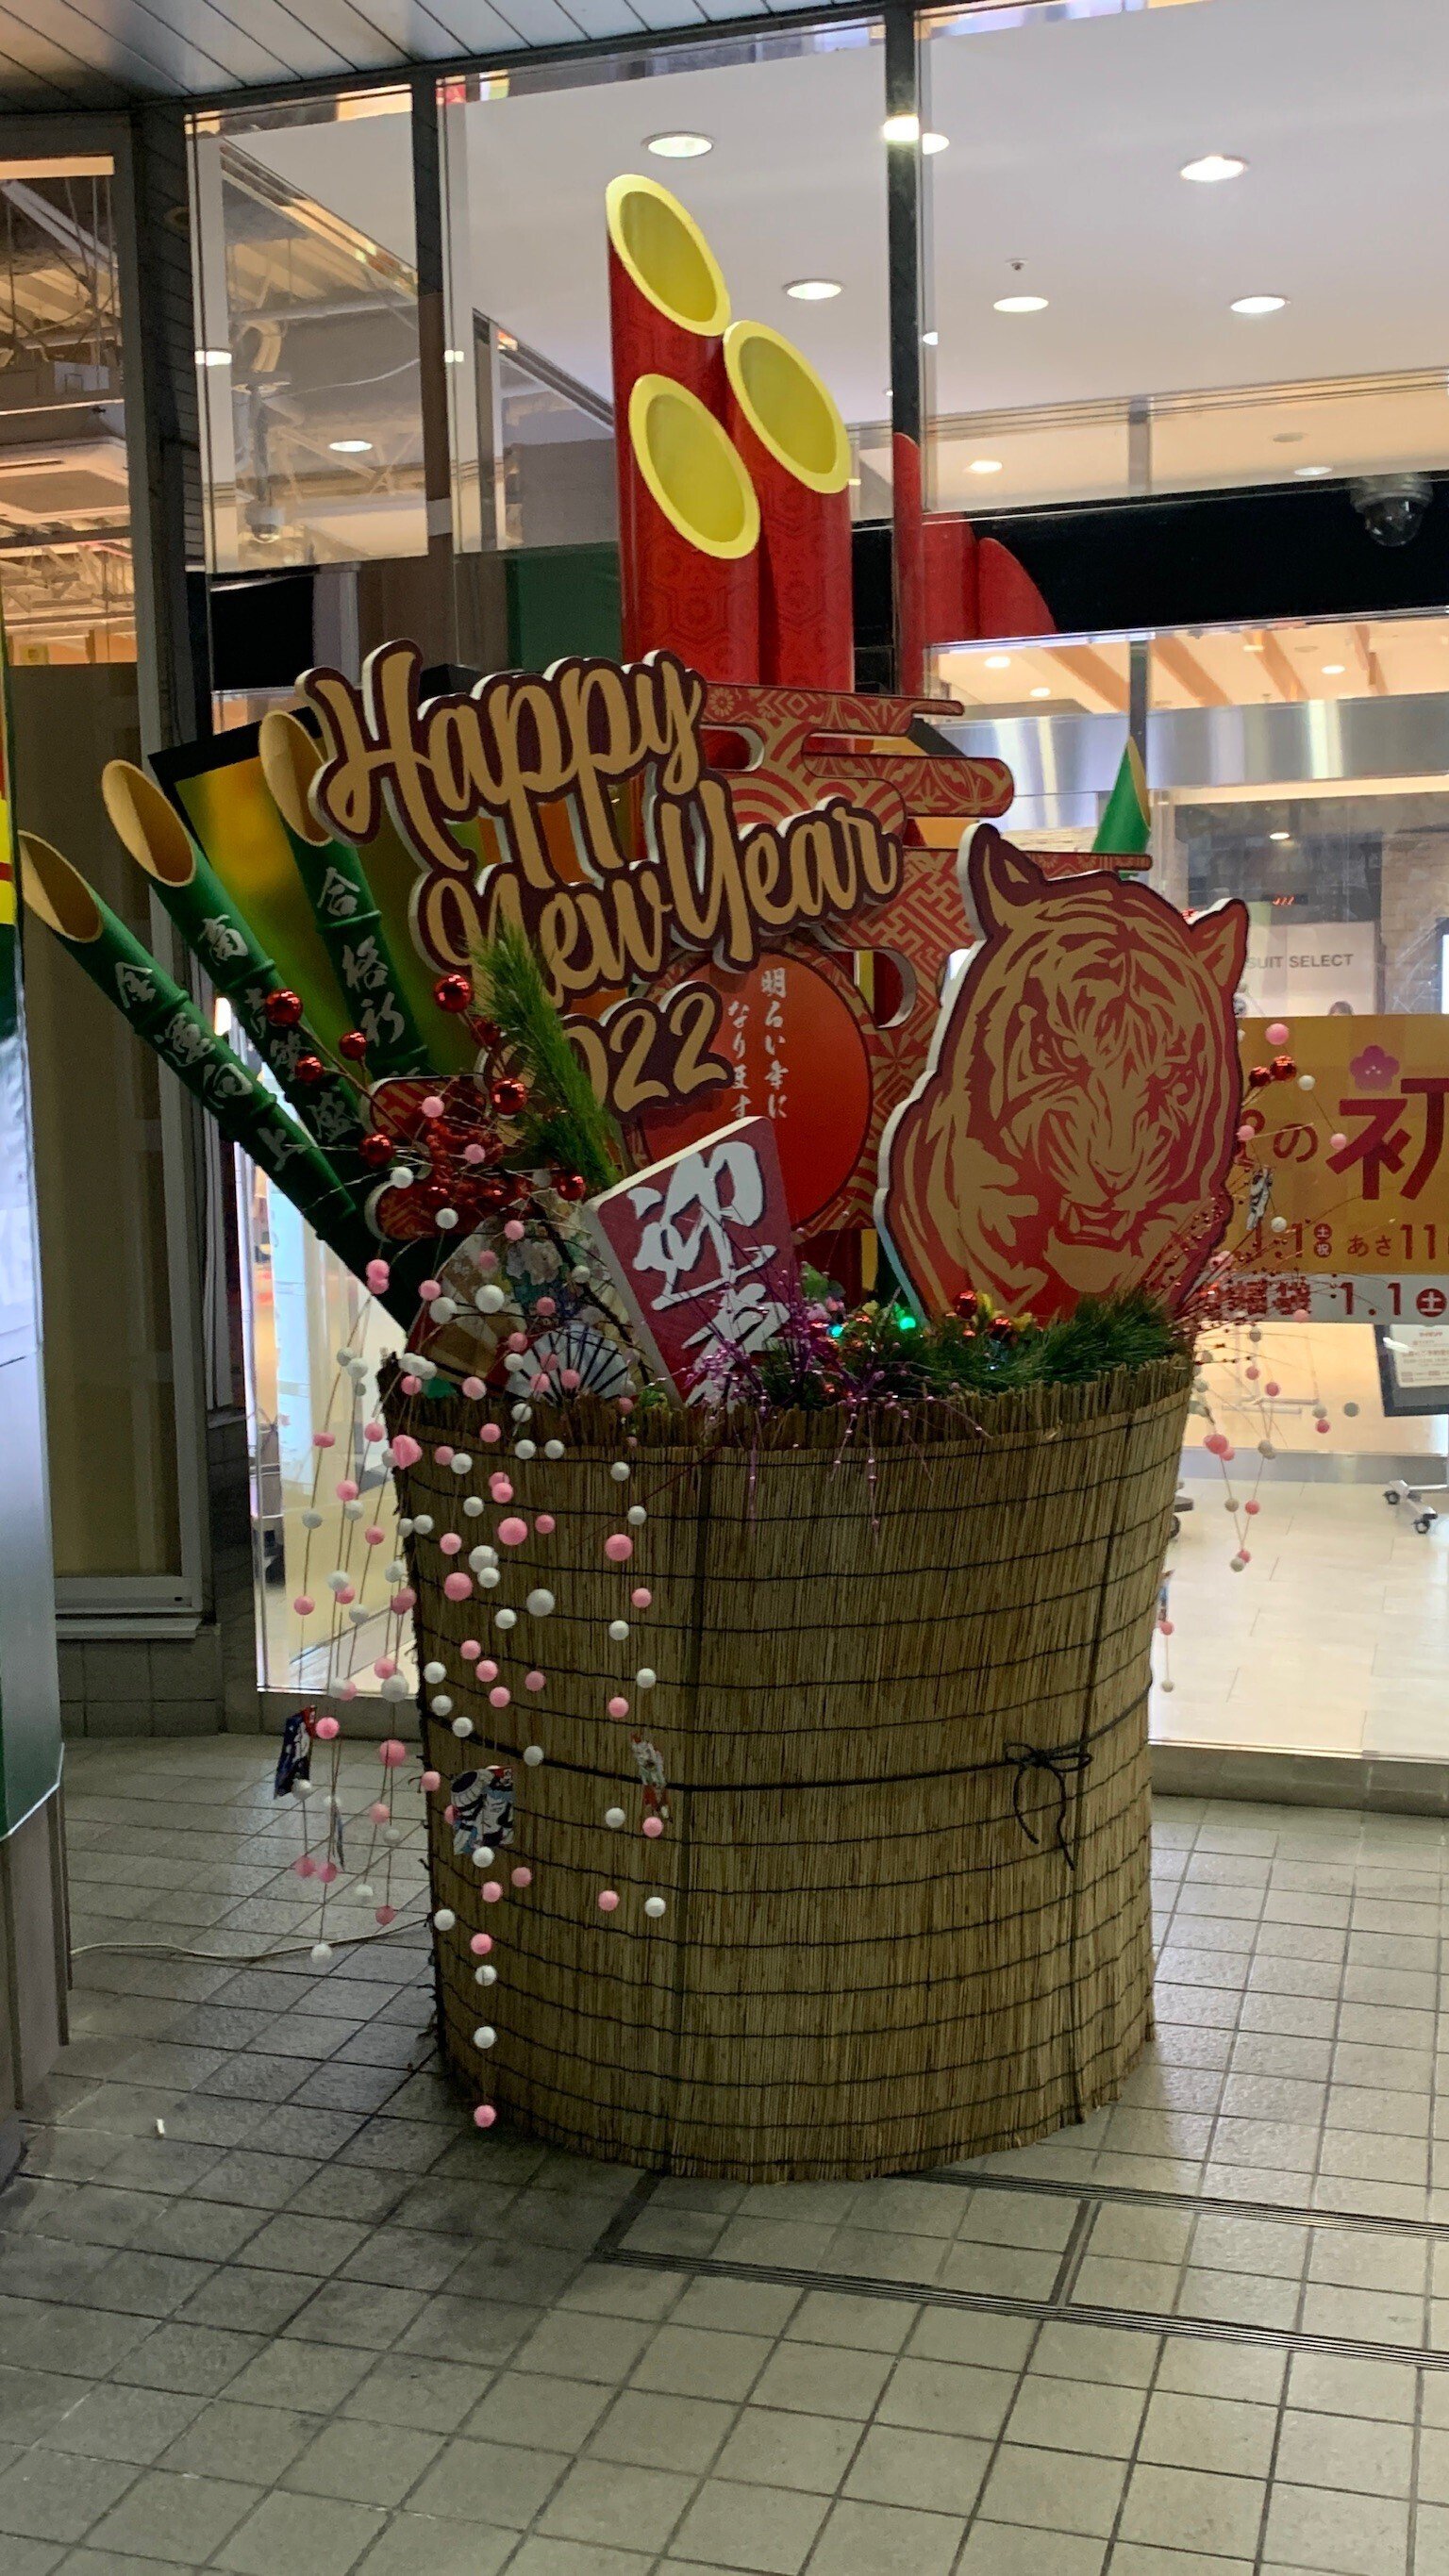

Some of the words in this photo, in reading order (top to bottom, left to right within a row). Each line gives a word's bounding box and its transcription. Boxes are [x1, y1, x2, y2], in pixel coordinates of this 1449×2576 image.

[319, 651, 701, 889] Happy
[318, 867, 421, 1077] 合格祈
[426, 870, 672, 1019] New
[662, 782, 897, 962] Year
[1246, 956, 1283, 970] SUIT
[1289, 954, 1354, 969] SELECT
[114, 960, 307, 1172] 金運向上
